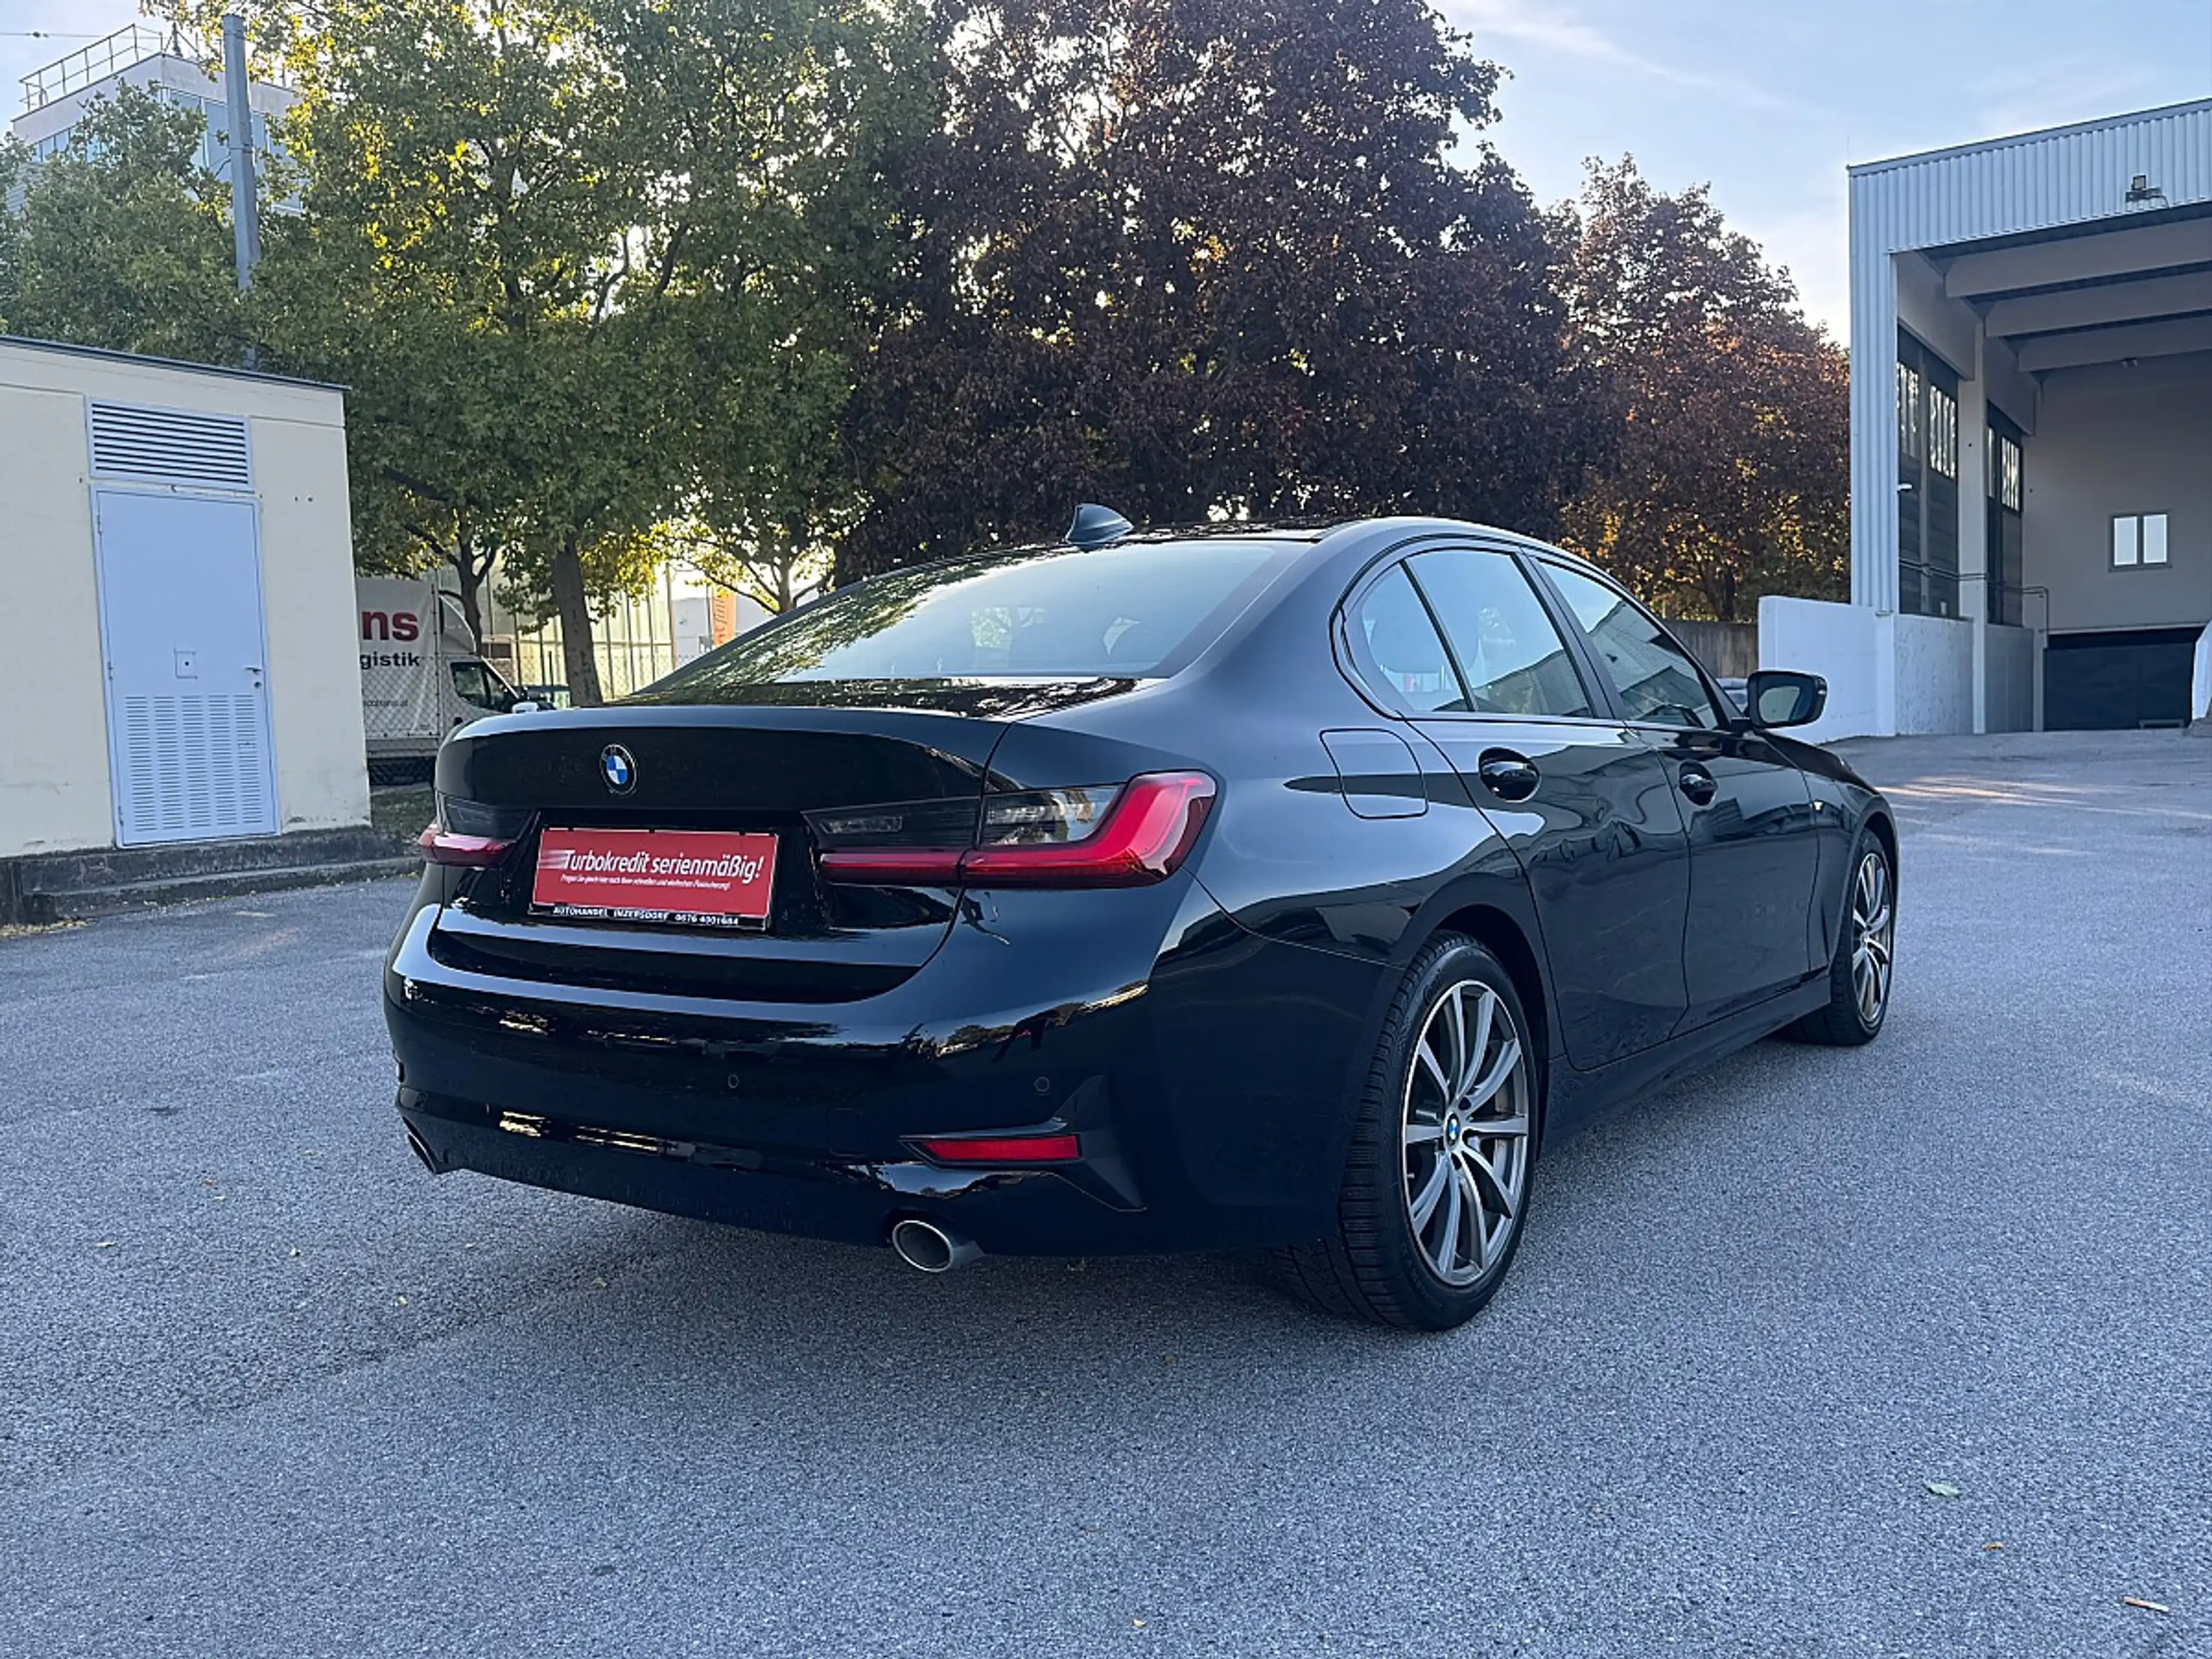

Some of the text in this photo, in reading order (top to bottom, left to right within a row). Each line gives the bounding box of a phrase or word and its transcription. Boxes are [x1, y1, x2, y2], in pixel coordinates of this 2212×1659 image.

[362, 611, 419, 641] ns
[360, 651, 419, 669] gistik
[563, 850, 649, 873] Turbokredit
[650, 852, 764, 884] serienmäßig!
[553, 906, 608, 916] AUTOHANDEL
